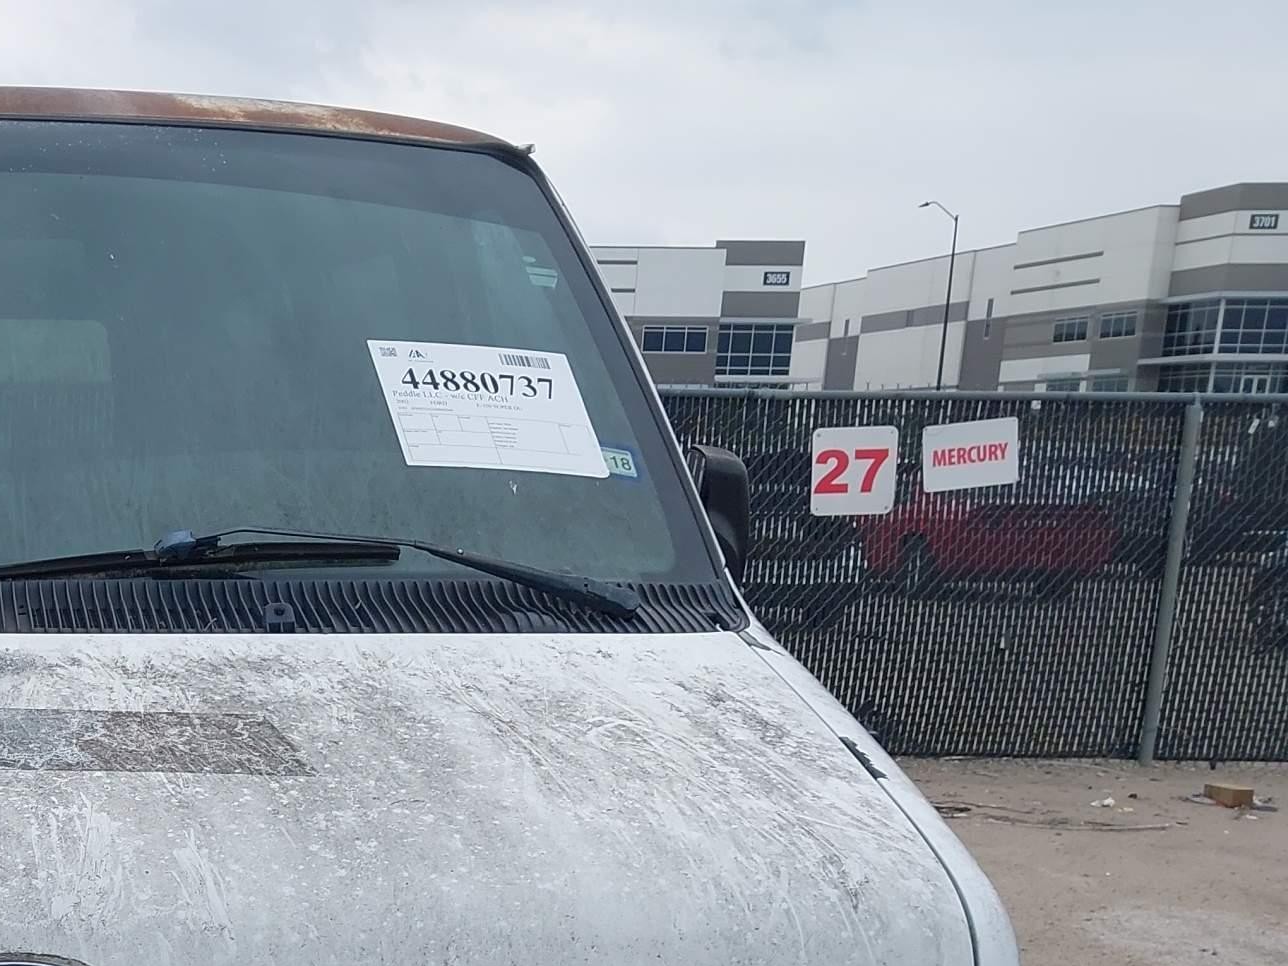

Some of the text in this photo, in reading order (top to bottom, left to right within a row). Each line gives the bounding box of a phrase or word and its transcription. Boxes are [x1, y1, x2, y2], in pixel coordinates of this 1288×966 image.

[401, 367, 553, 400] 44880737
[609, 455, 632, 471] 18
[932, 442, 1009, 468] MERCURY
[813, 448, 890, 494] 27
